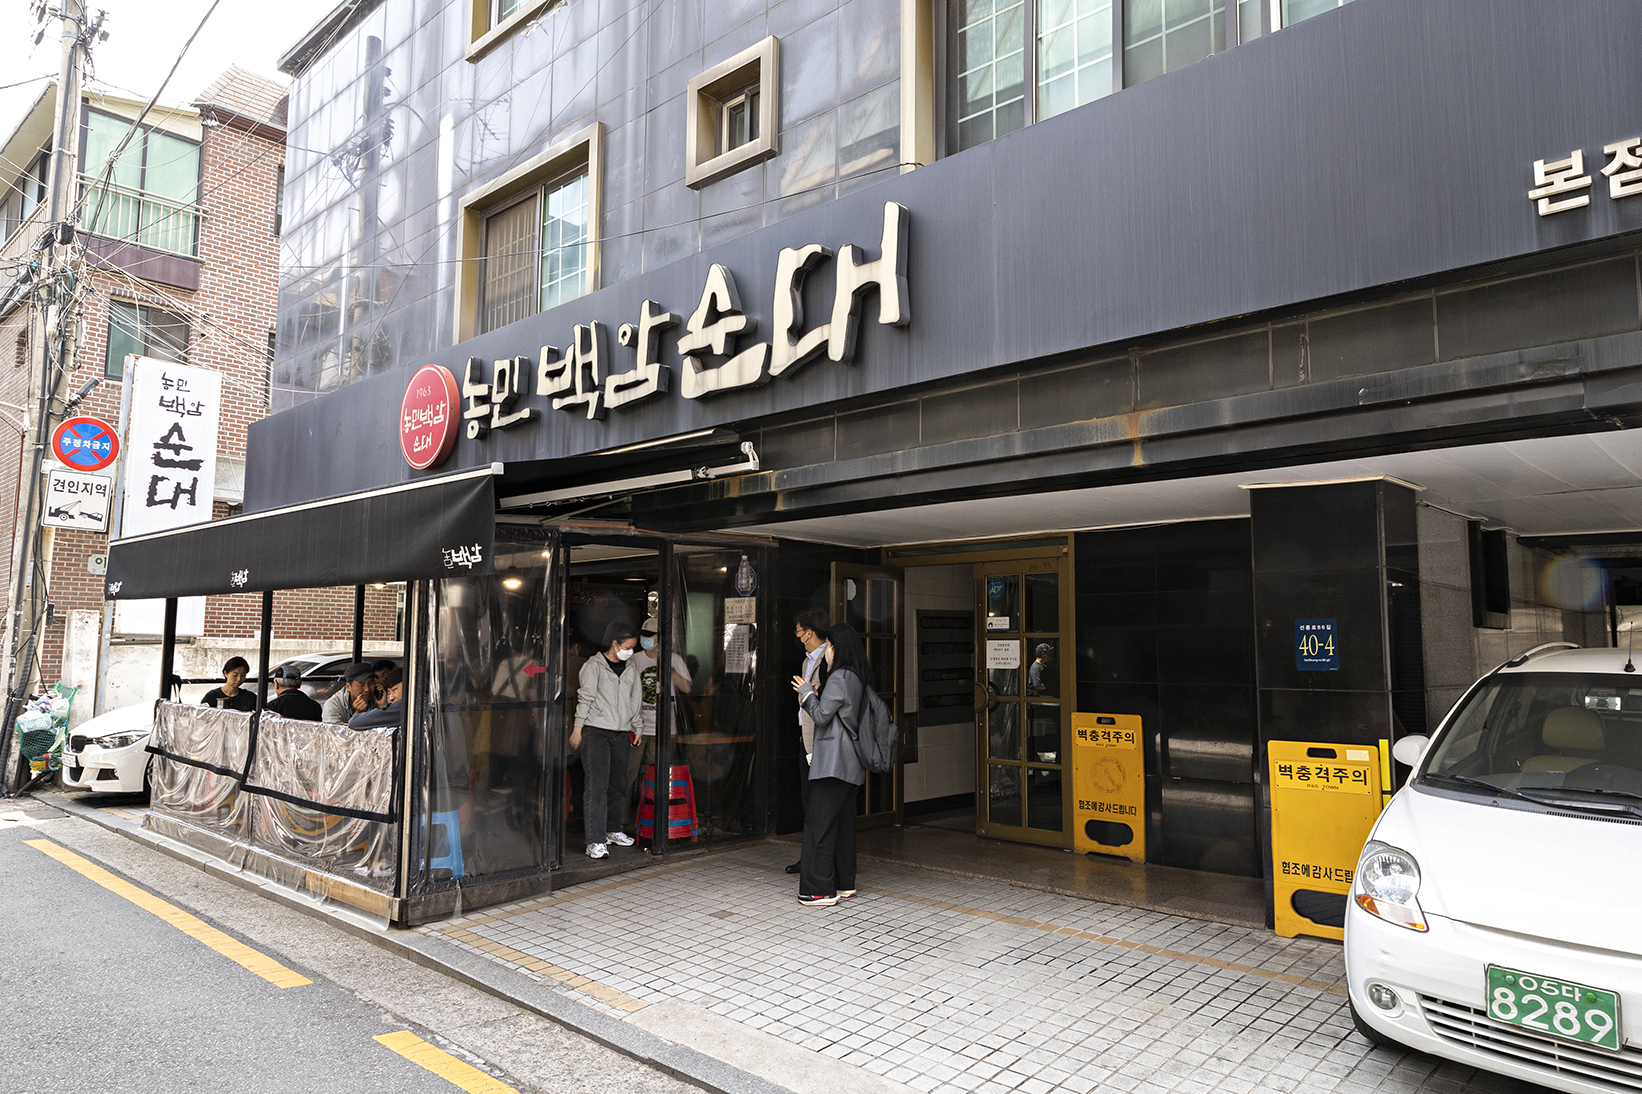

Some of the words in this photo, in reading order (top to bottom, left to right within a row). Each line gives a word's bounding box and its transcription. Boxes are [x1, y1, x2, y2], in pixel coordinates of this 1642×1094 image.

[1528, 136, 1642, 217] 본점
[462, 355, 539, 440] 농민
[536, 298, 681, 421] 백암
[677, 200, 911, 401] 순대
[161, 371, 190, 393] 농민
[416, 385, 432, 399] 1963
[158, 395, 206, 418] 백암
[403, 400, 447, 434] 농민백암
[62, 436, 111, 451] 주정차금지
[413, 431, 432, 453] 순대
[146, 421, 206, 511] 순대
[52, 478, 107, 498] 견인지역
[989, 585, 1003, 594] ADT
[1298, 634, 1335, 656] 40-4
[1076, 728, 1136, 745] 벽충격주의
[1278, 764, 1367, 786] 벽충격주의
[1078, 799, 1097, 812] 협조에
[1281, 861, 1310, 877] 협조에
[1312, 865, 1354, 884] 감사드립
[1518, 976, 1582, 1002] 05다
[1491, 987, 1614, 1043] 8289
